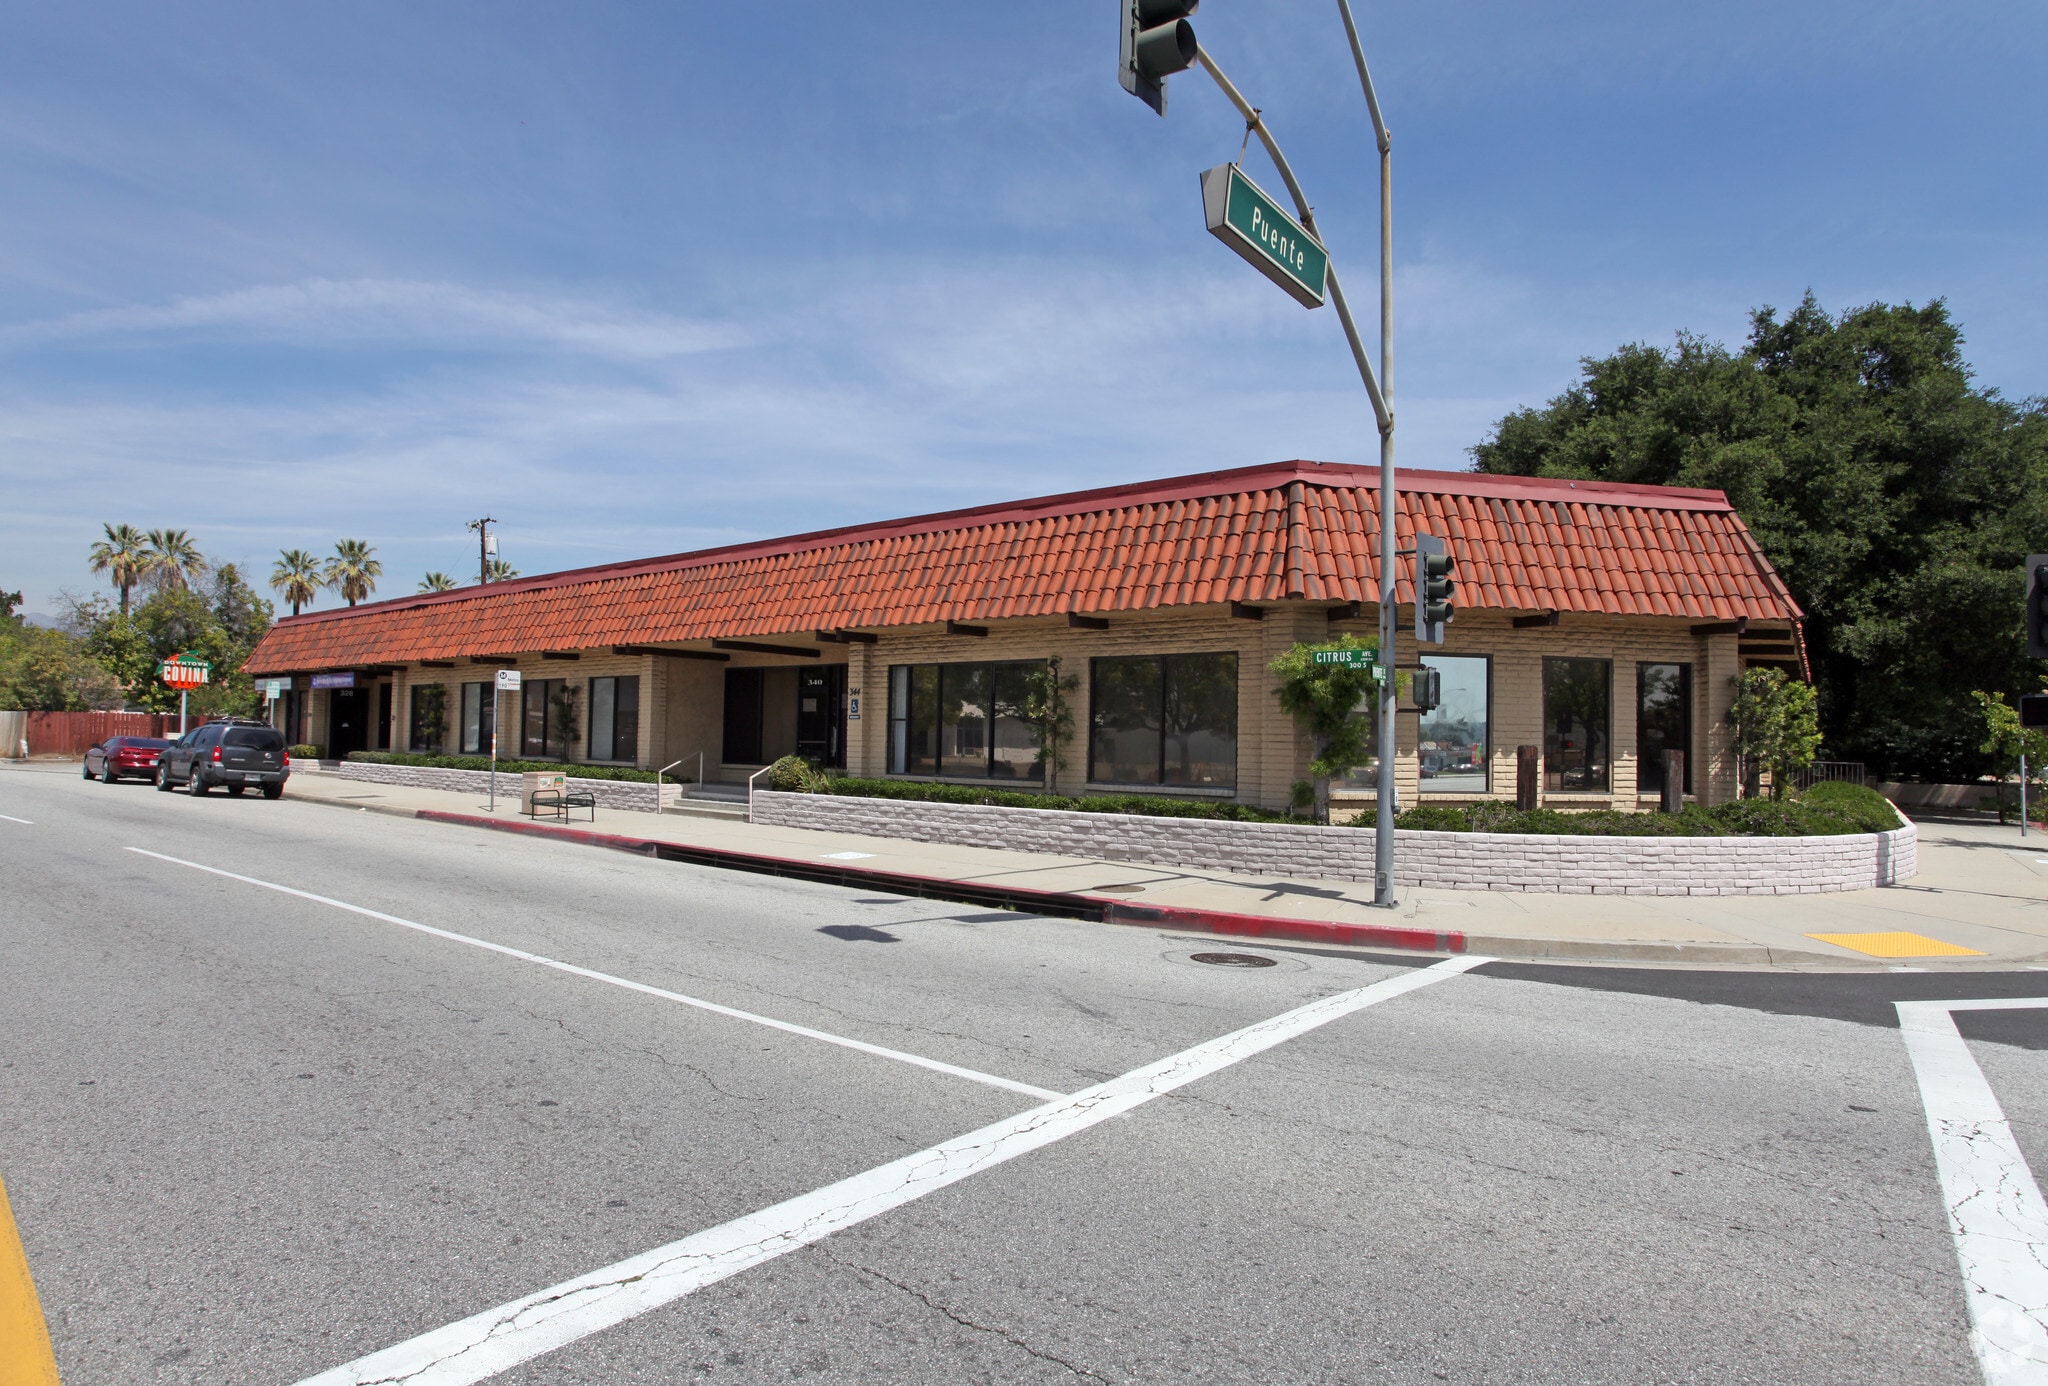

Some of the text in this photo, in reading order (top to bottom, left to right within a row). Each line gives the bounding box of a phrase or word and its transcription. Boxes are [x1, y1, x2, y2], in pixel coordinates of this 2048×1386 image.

[1252, 206, 1304, 271] Puente
[1316, 651, 1352, 663] CITRUS
[163, 666, 209, 683] COVINA
[340, 689, 354, 697] 328
